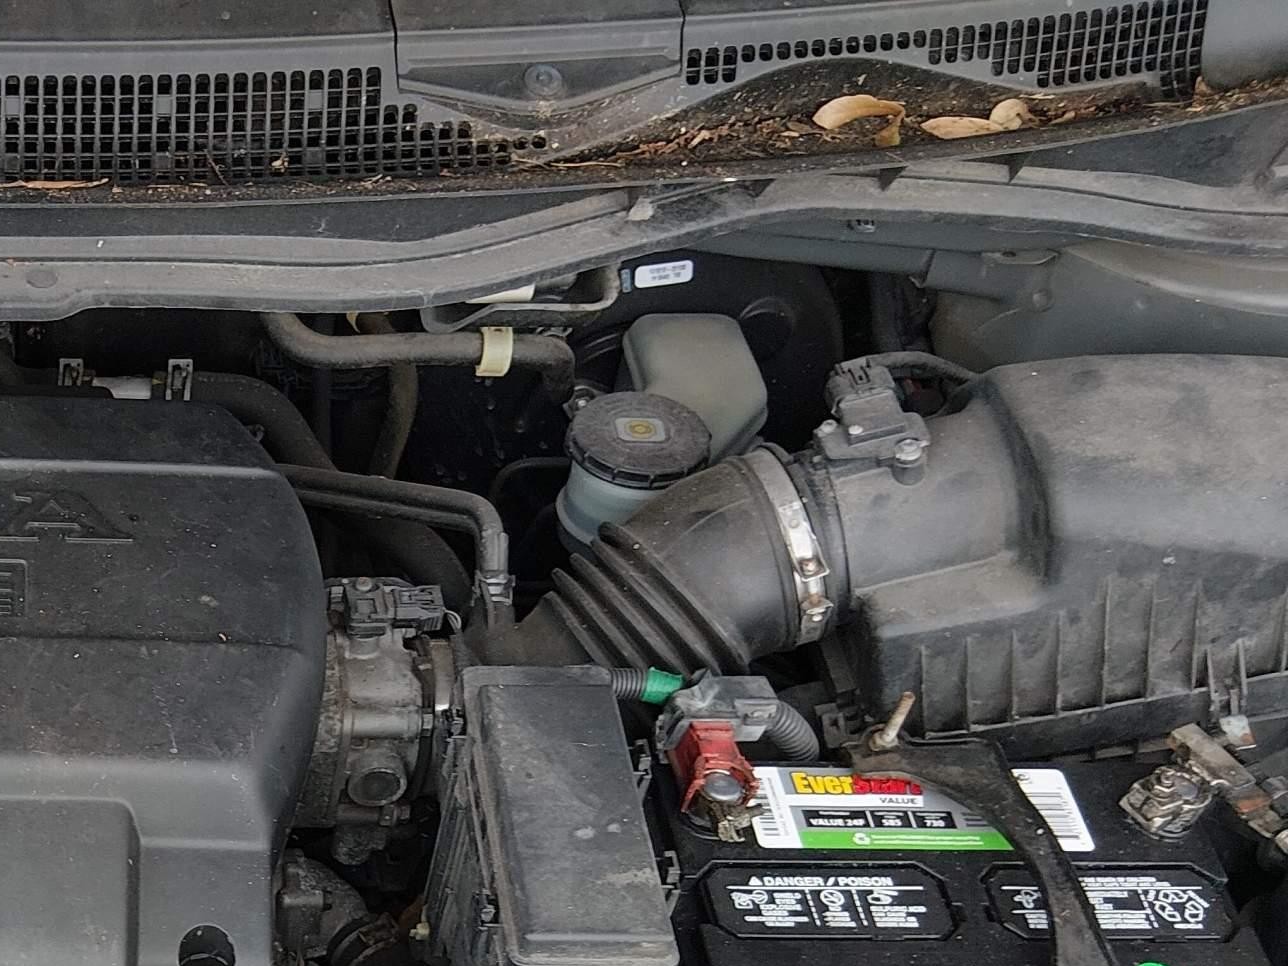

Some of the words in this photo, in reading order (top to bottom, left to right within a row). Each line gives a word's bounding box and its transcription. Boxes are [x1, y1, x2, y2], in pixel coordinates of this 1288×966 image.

[879, 797, 918, 805] VALUE
[763, 876, 823, 886] DANGER
[837, 876, 894, 887] POISON
